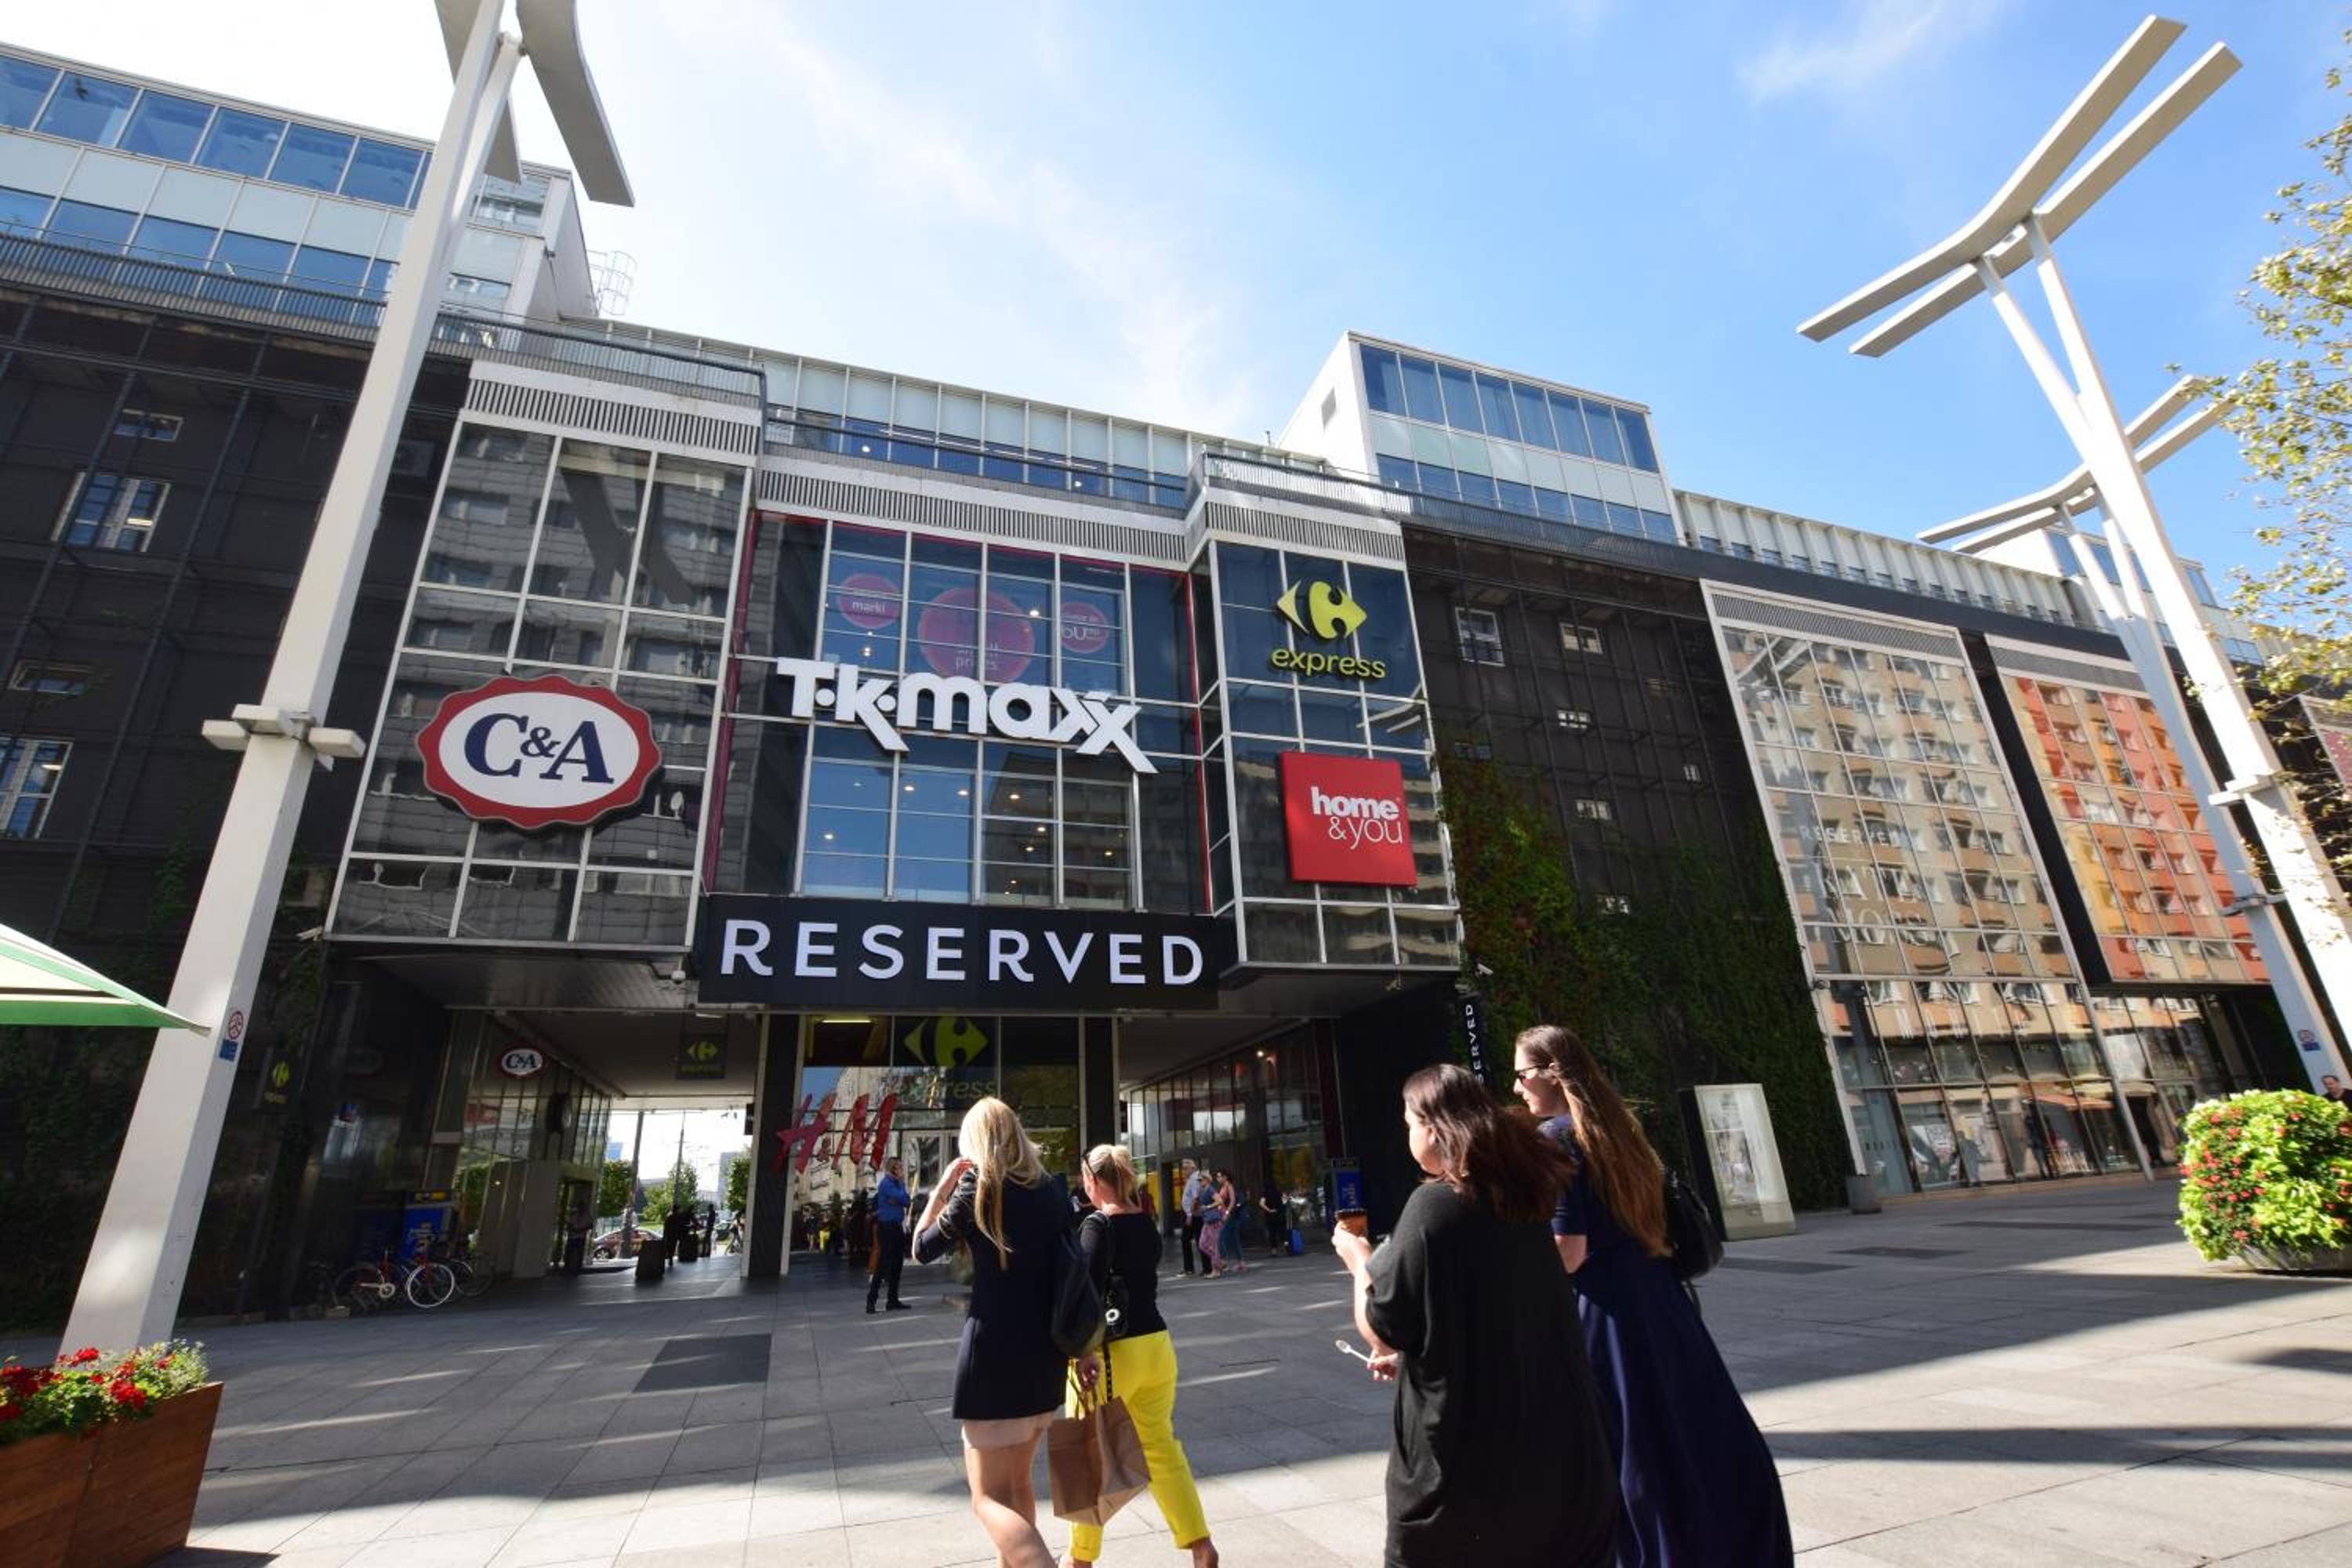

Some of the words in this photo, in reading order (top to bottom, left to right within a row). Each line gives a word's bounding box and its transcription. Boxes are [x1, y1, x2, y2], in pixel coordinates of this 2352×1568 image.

[1272, 647, 1386, 679] express
[464, 713, 615, 785] C&A
[1311, 786, 1399, 819] home
[720, 919, 1204, 985] RESERVED
[505, 1053, 537, 1069] C&A
[1465, 1004, 1484, 1085] SERVED
[774, 1092, 899, 1174] H&M
